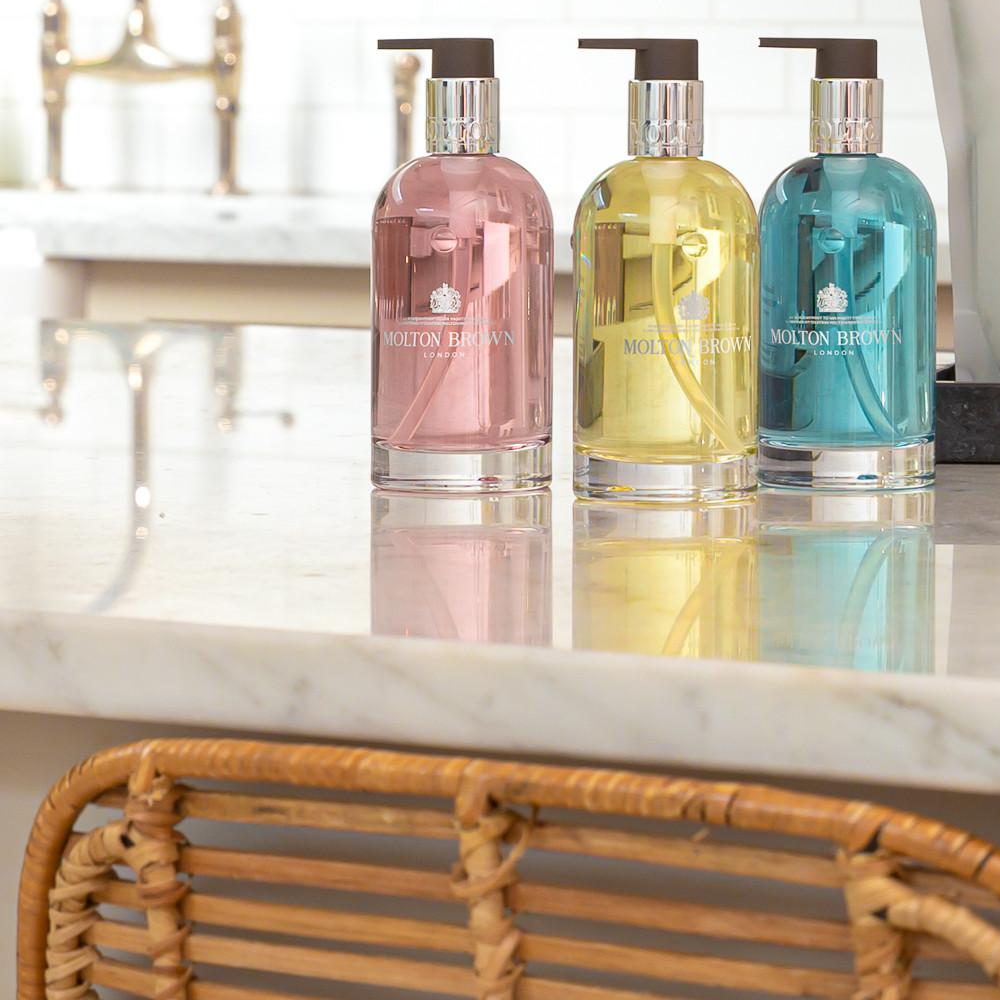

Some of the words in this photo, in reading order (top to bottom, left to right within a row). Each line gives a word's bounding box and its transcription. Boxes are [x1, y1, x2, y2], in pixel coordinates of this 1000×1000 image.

[384, 332, 440, 347] MOLTON
[448, 332, 515, 347] BROWN
[771, 329, 829, 345] MOLTON
[838, 329, 902, 345] BROWN
[624, 339, 691, 355] MOLTON
[700, 336, 752, 354] BROWN
